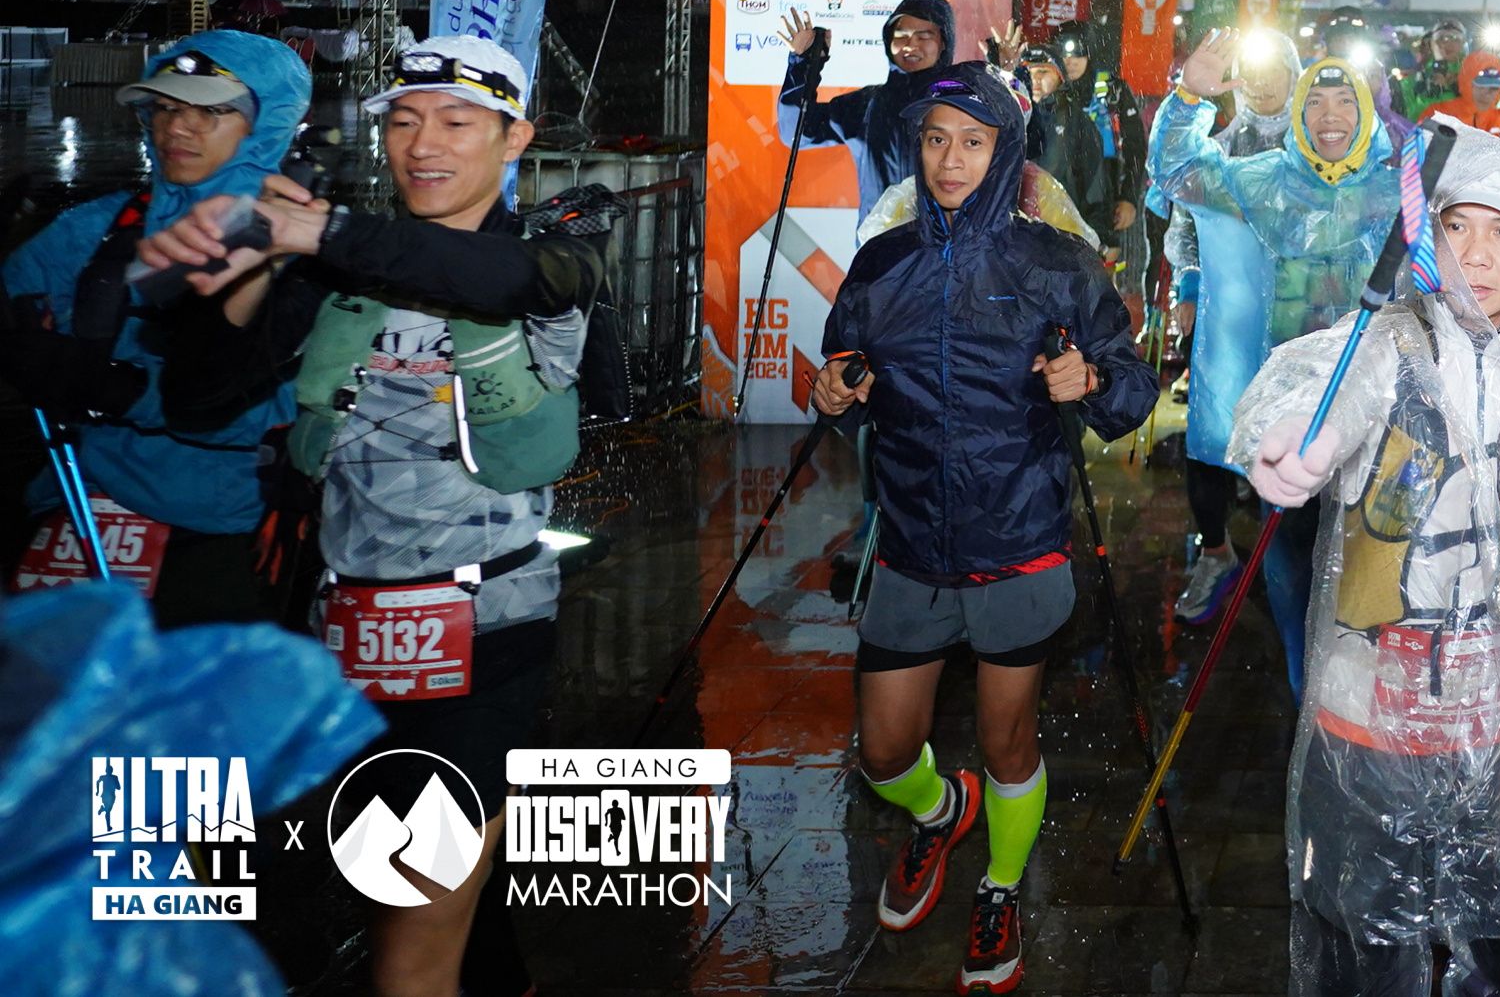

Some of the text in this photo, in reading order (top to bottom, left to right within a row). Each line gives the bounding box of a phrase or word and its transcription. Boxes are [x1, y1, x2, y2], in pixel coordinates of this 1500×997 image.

[745, 298, 789, 330] HG
[468, 396, 517, 416] KAILAS
[358, 617, 445, 662] 5132
